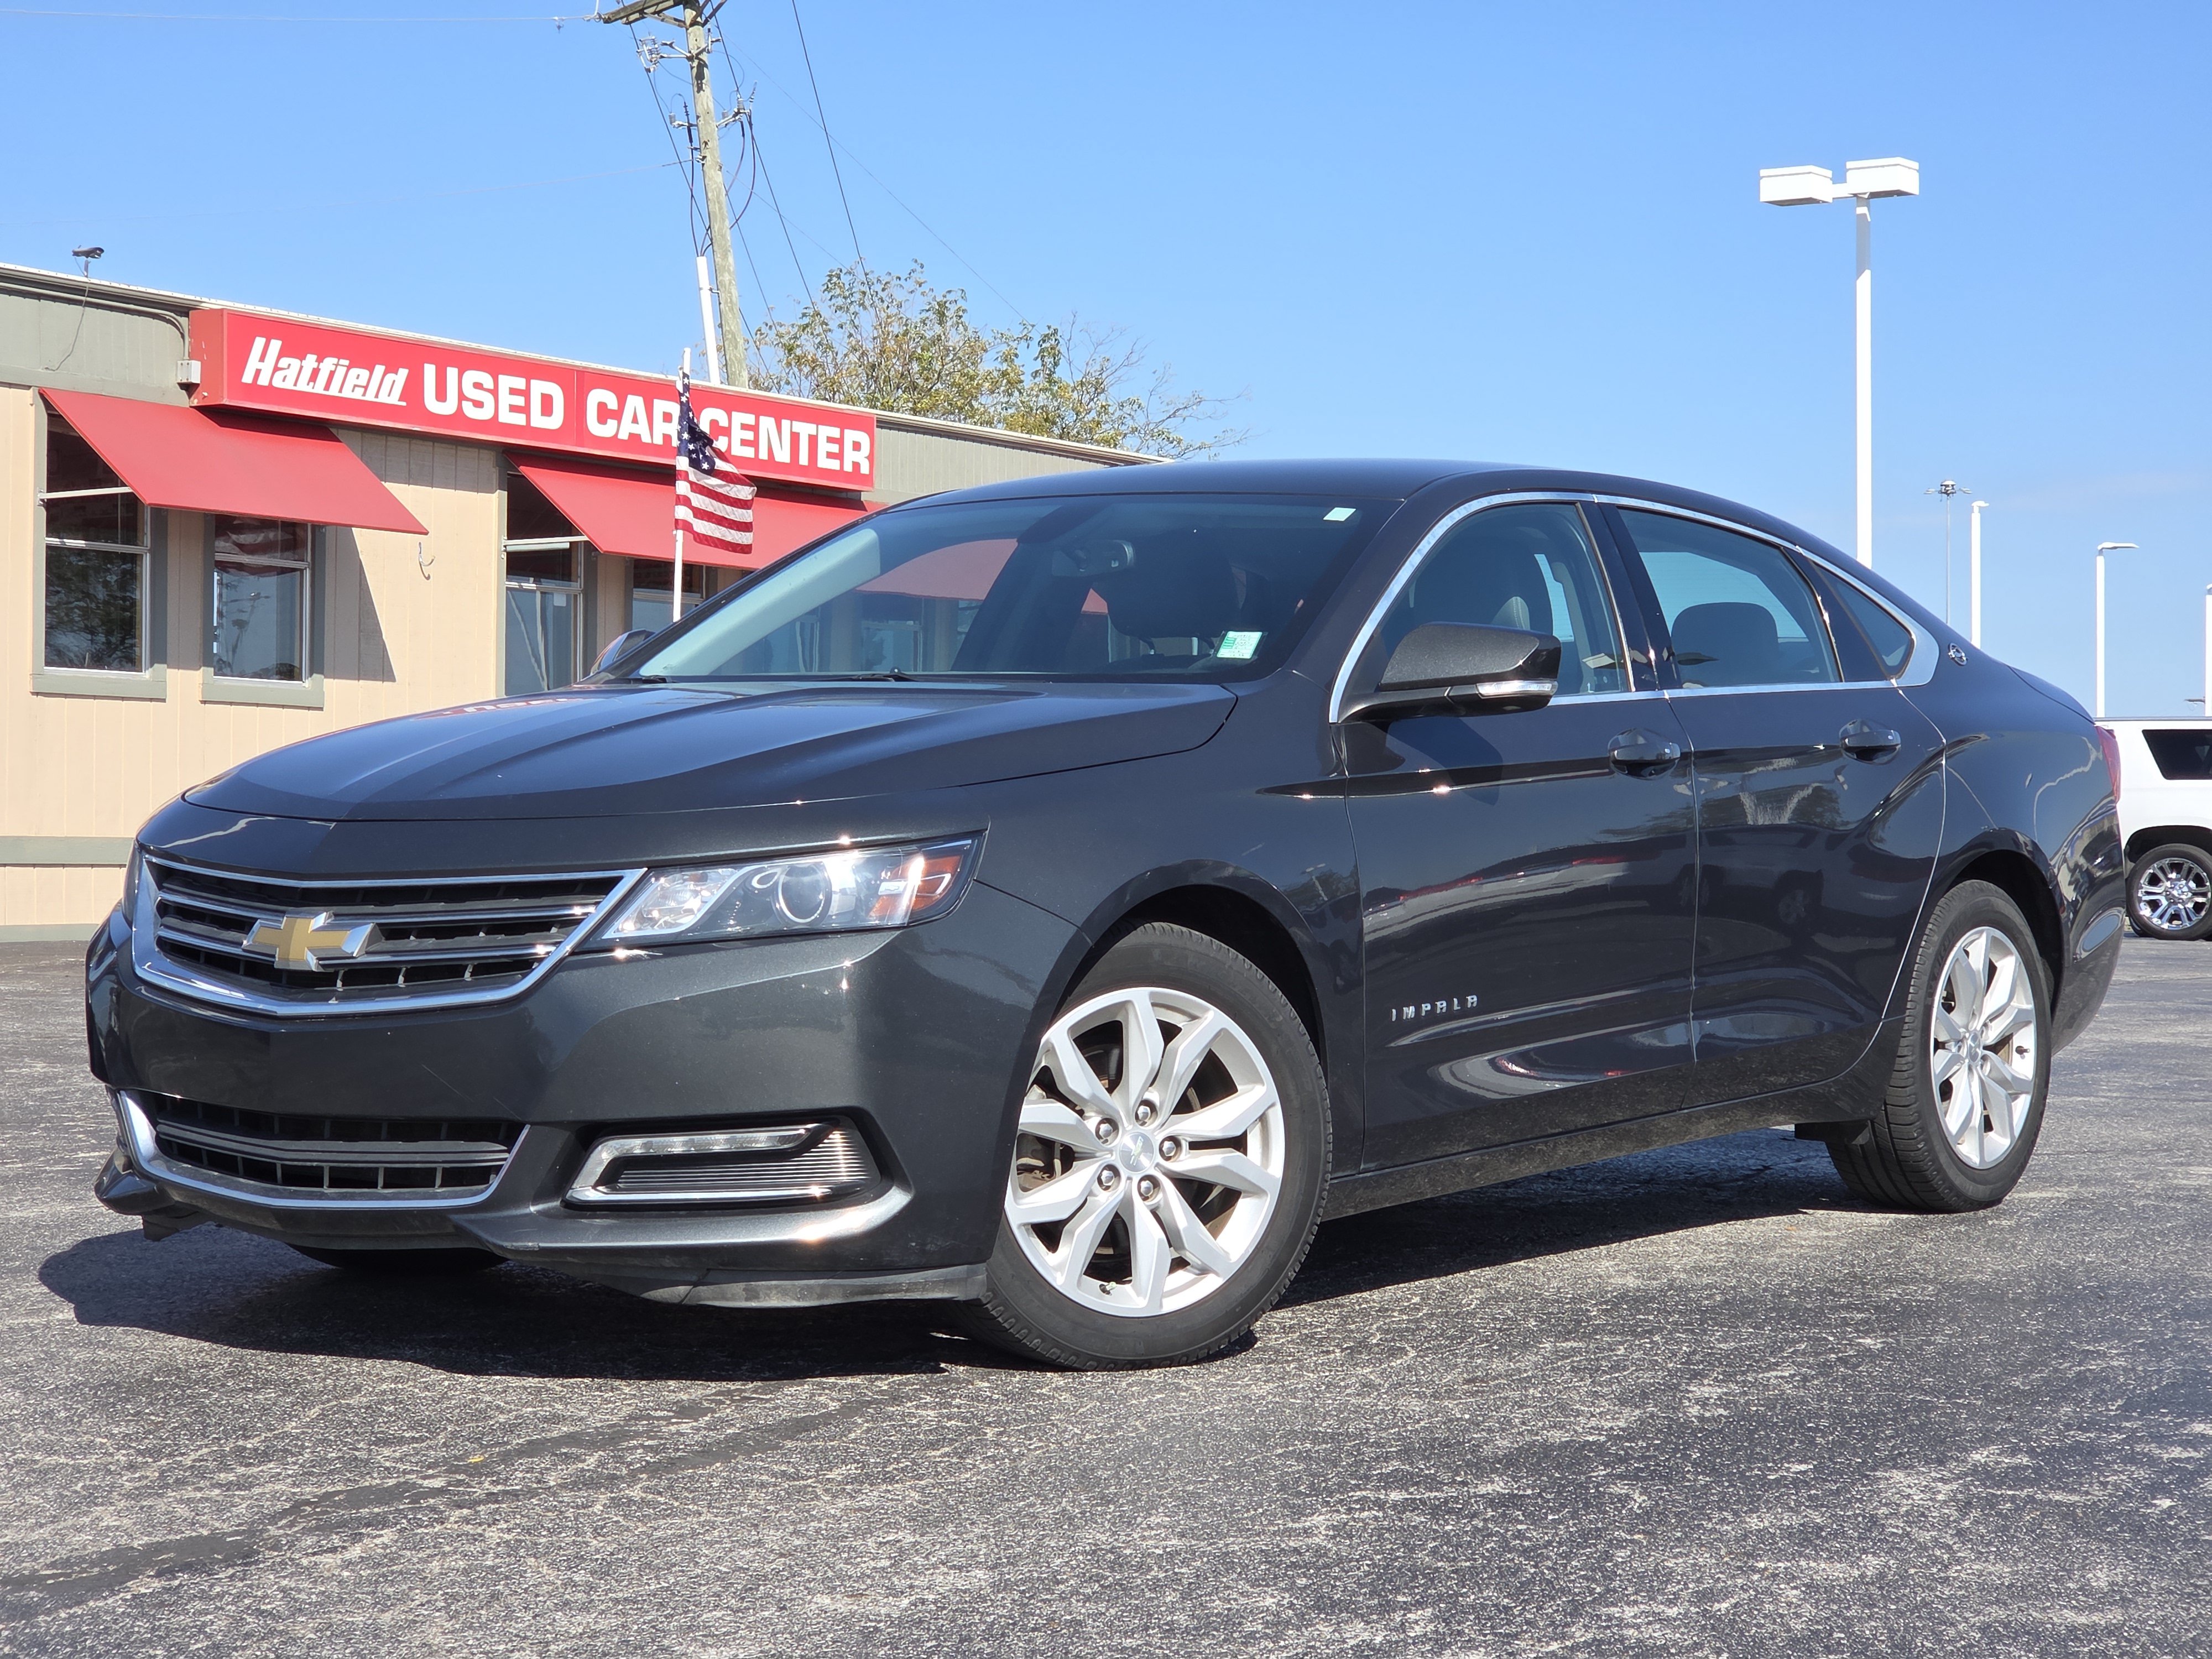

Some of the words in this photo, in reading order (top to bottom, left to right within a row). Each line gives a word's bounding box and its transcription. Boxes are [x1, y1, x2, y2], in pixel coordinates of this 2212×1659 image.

[241, 336, 409, 406] Hatfield
[424, 363, 564, 430] USED
[586, 388, 681, 447] CAR
[698, 407, 870, 474] CENTER
[1391, 995, 1478, 1021] IMPALA
